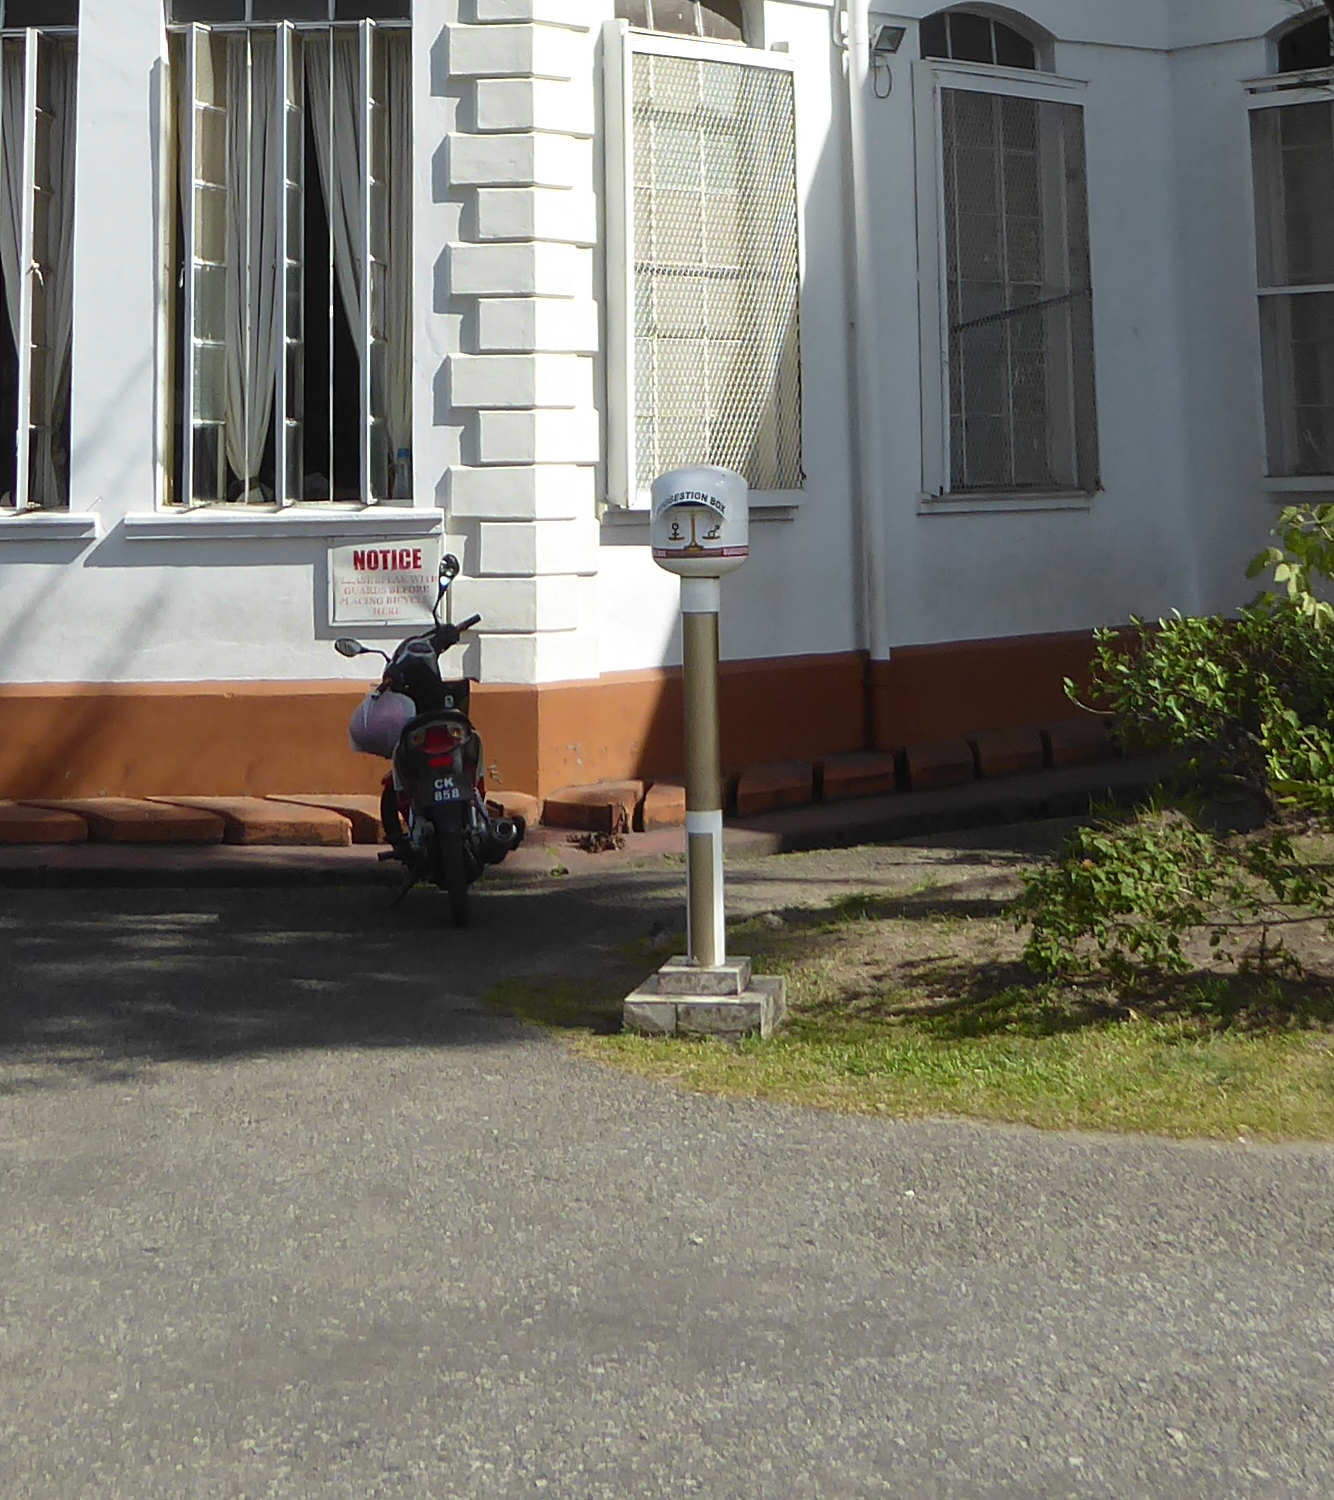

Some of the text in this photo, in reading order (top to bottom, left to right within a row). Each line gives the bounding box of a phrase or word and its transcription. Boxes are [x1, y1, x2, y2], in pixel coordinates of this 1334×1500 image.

[709, 496, 727, 514] BOX
[353, 548, 422, 571] NOTICE
[434, 777, 455, 790] CK
